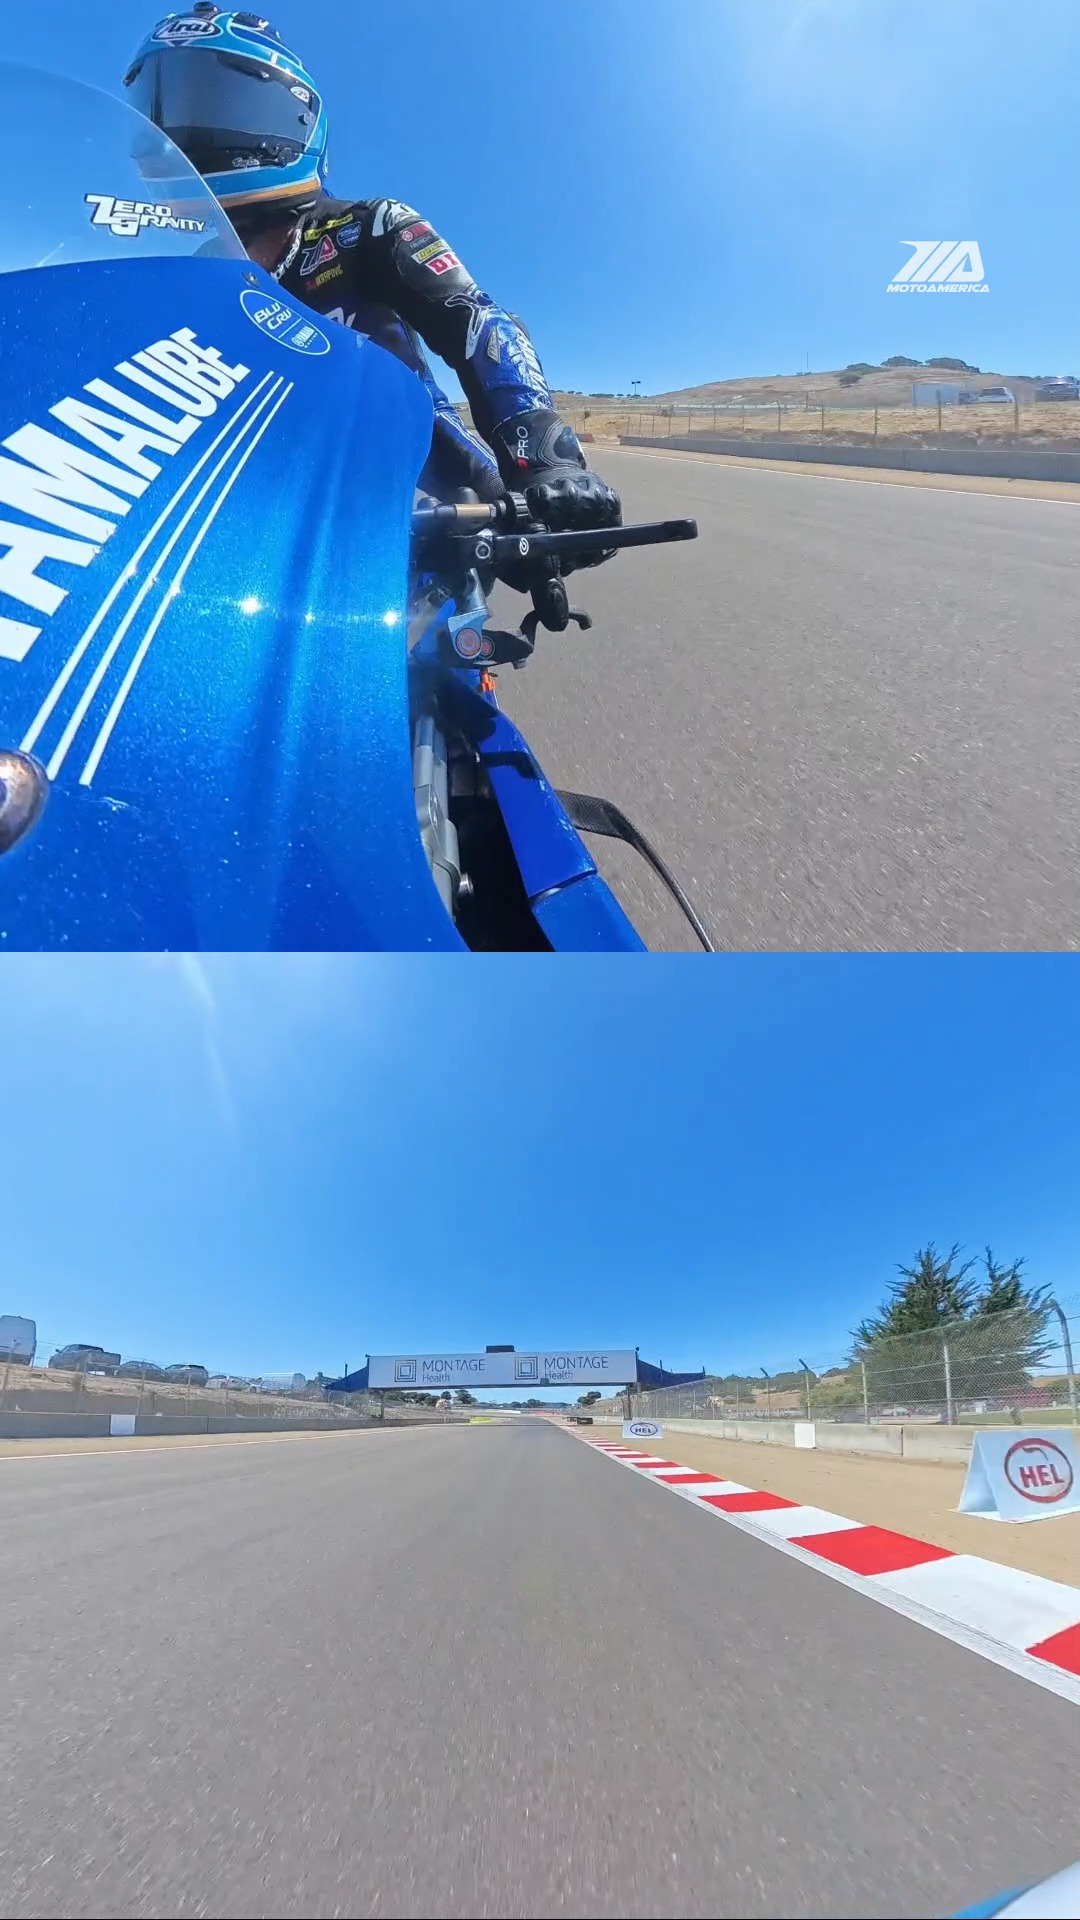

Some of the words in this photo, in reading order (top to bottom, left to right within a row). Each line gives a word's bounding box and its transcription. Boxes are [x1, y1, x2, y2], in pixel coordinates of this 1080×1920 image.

[168, 20, 211, 33] Arai
[85, 194, 172, 226] ZERO
[110, 212, 206, 236] GRAVITY
[516, 425, 530, 460] PRO
[422, 1359, 486, 1372] MONTAGE
[544, 1356, 609, 1369] MONTAGE
[422, 1374, 451, 1383] Health
[544, 1371, 573, 1382] Health
[1019, 1464, 1066, 1489] HEL
